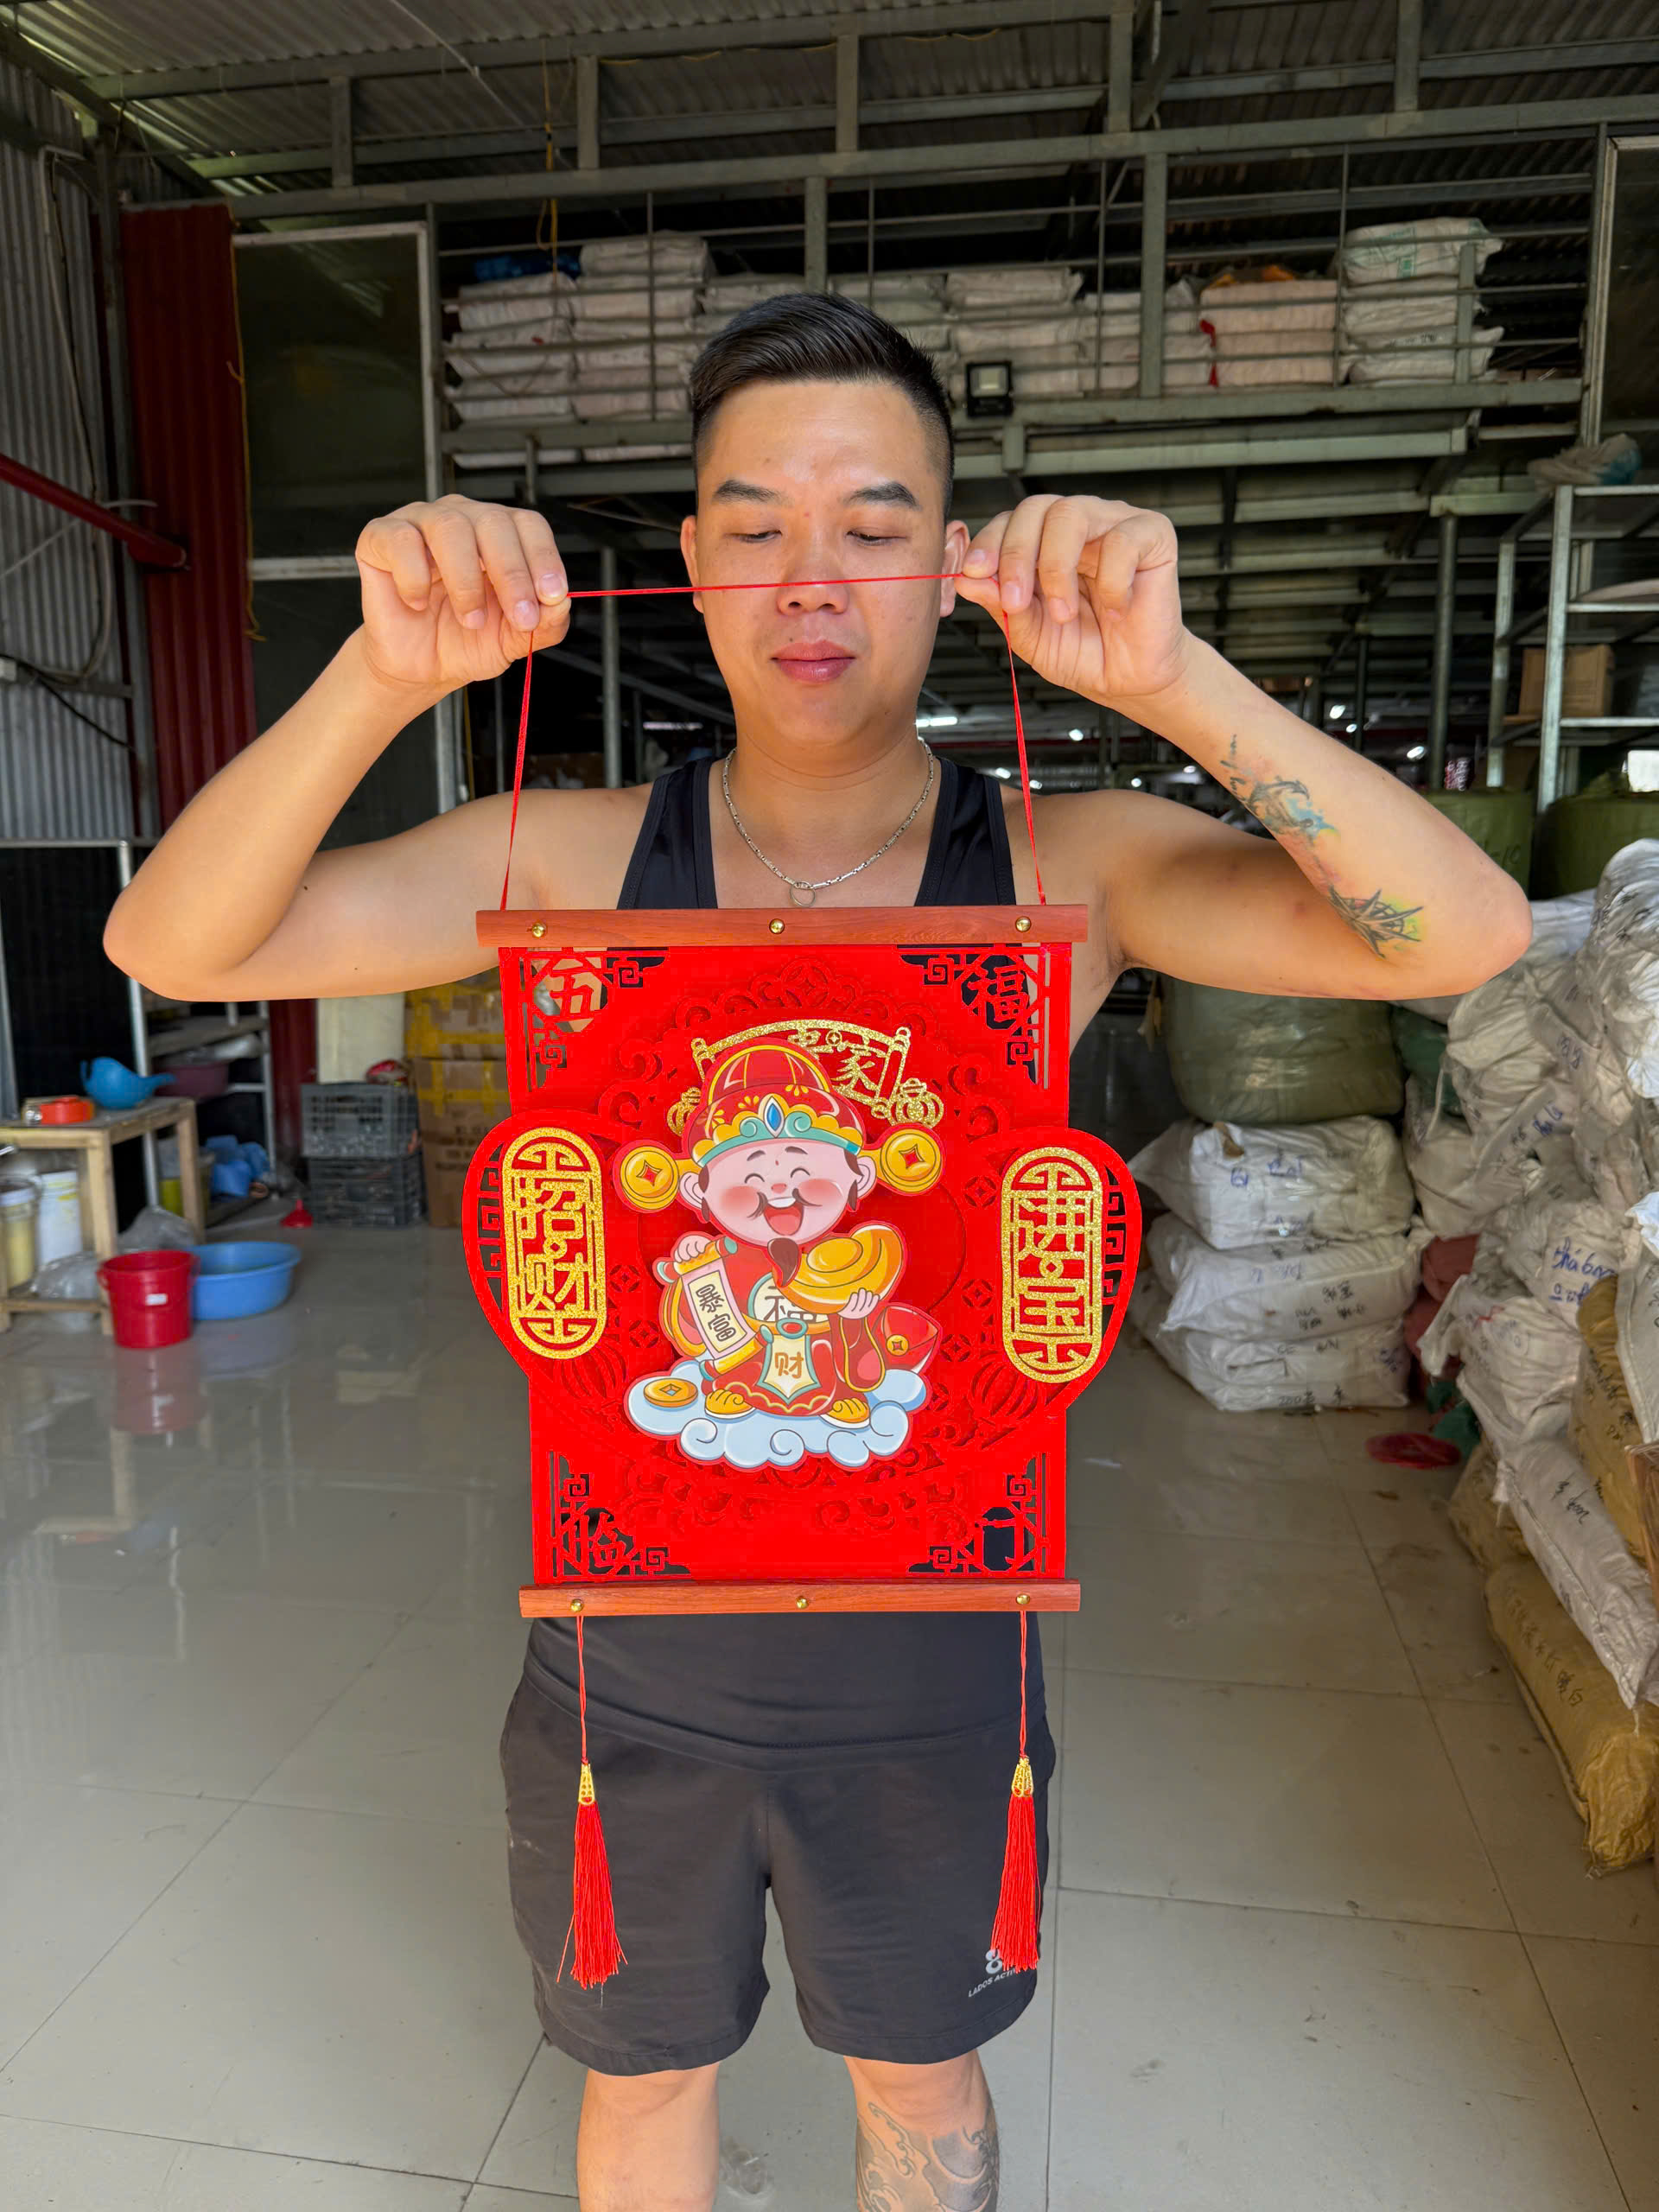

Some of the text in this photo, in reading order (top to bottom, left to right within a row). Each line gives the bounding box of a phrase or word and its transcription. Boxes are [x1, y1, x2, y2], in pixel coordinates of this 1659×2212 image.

[549, 964, 599, 1021] 五
[966, 963, 1030, 1025] 福
[518, 1176, 588, 1312] 招财
[1017, 1197, 1088, 1332] 进宝
[695, 1283, 737, 1342] 暴富
[774, 1351, 804, 1379] 财
[974, 1518, 1025, 1567] 门
[968, 1976, 994, 1998] LADOS
